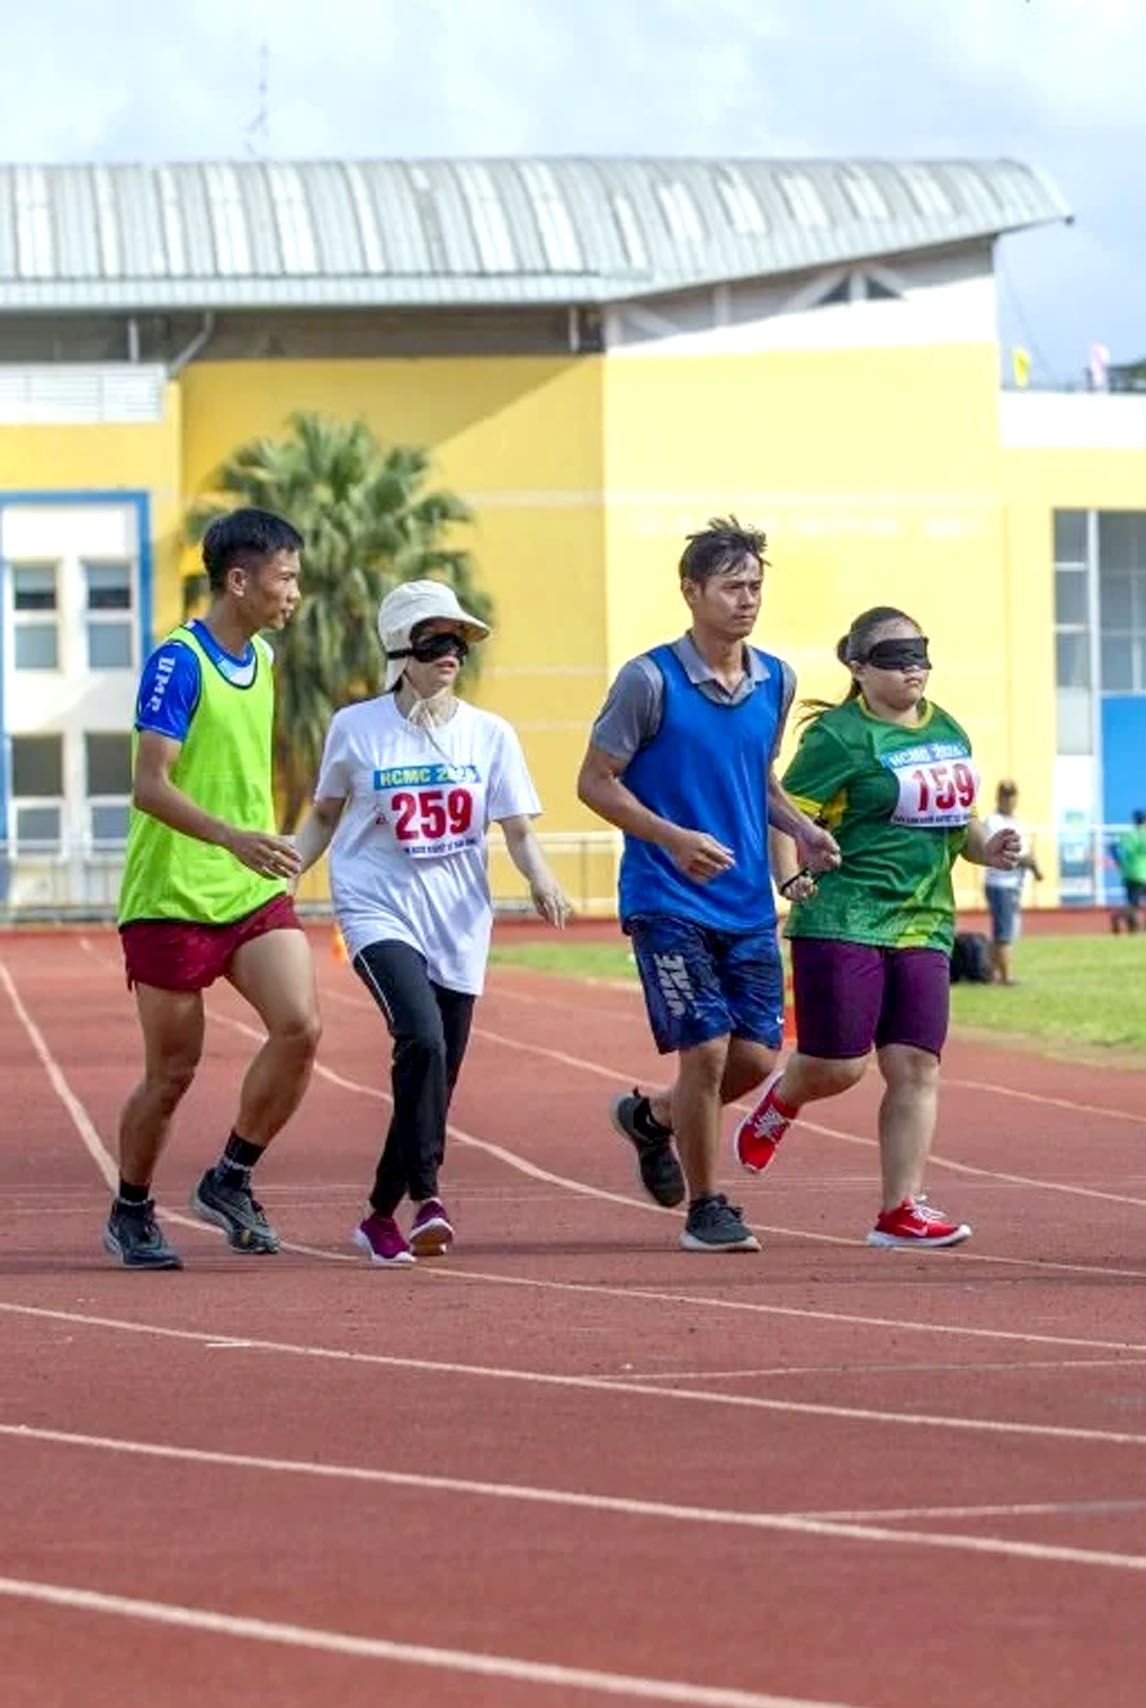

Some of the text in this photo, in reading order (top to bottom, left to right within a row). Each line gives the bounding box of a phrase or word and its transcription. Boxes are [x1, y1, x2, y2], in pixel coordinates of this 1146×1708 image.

[382, 767, 431, 786] HCMC
[912, 763, 975, 812] 159
[391, 788, 473, 841] 259
